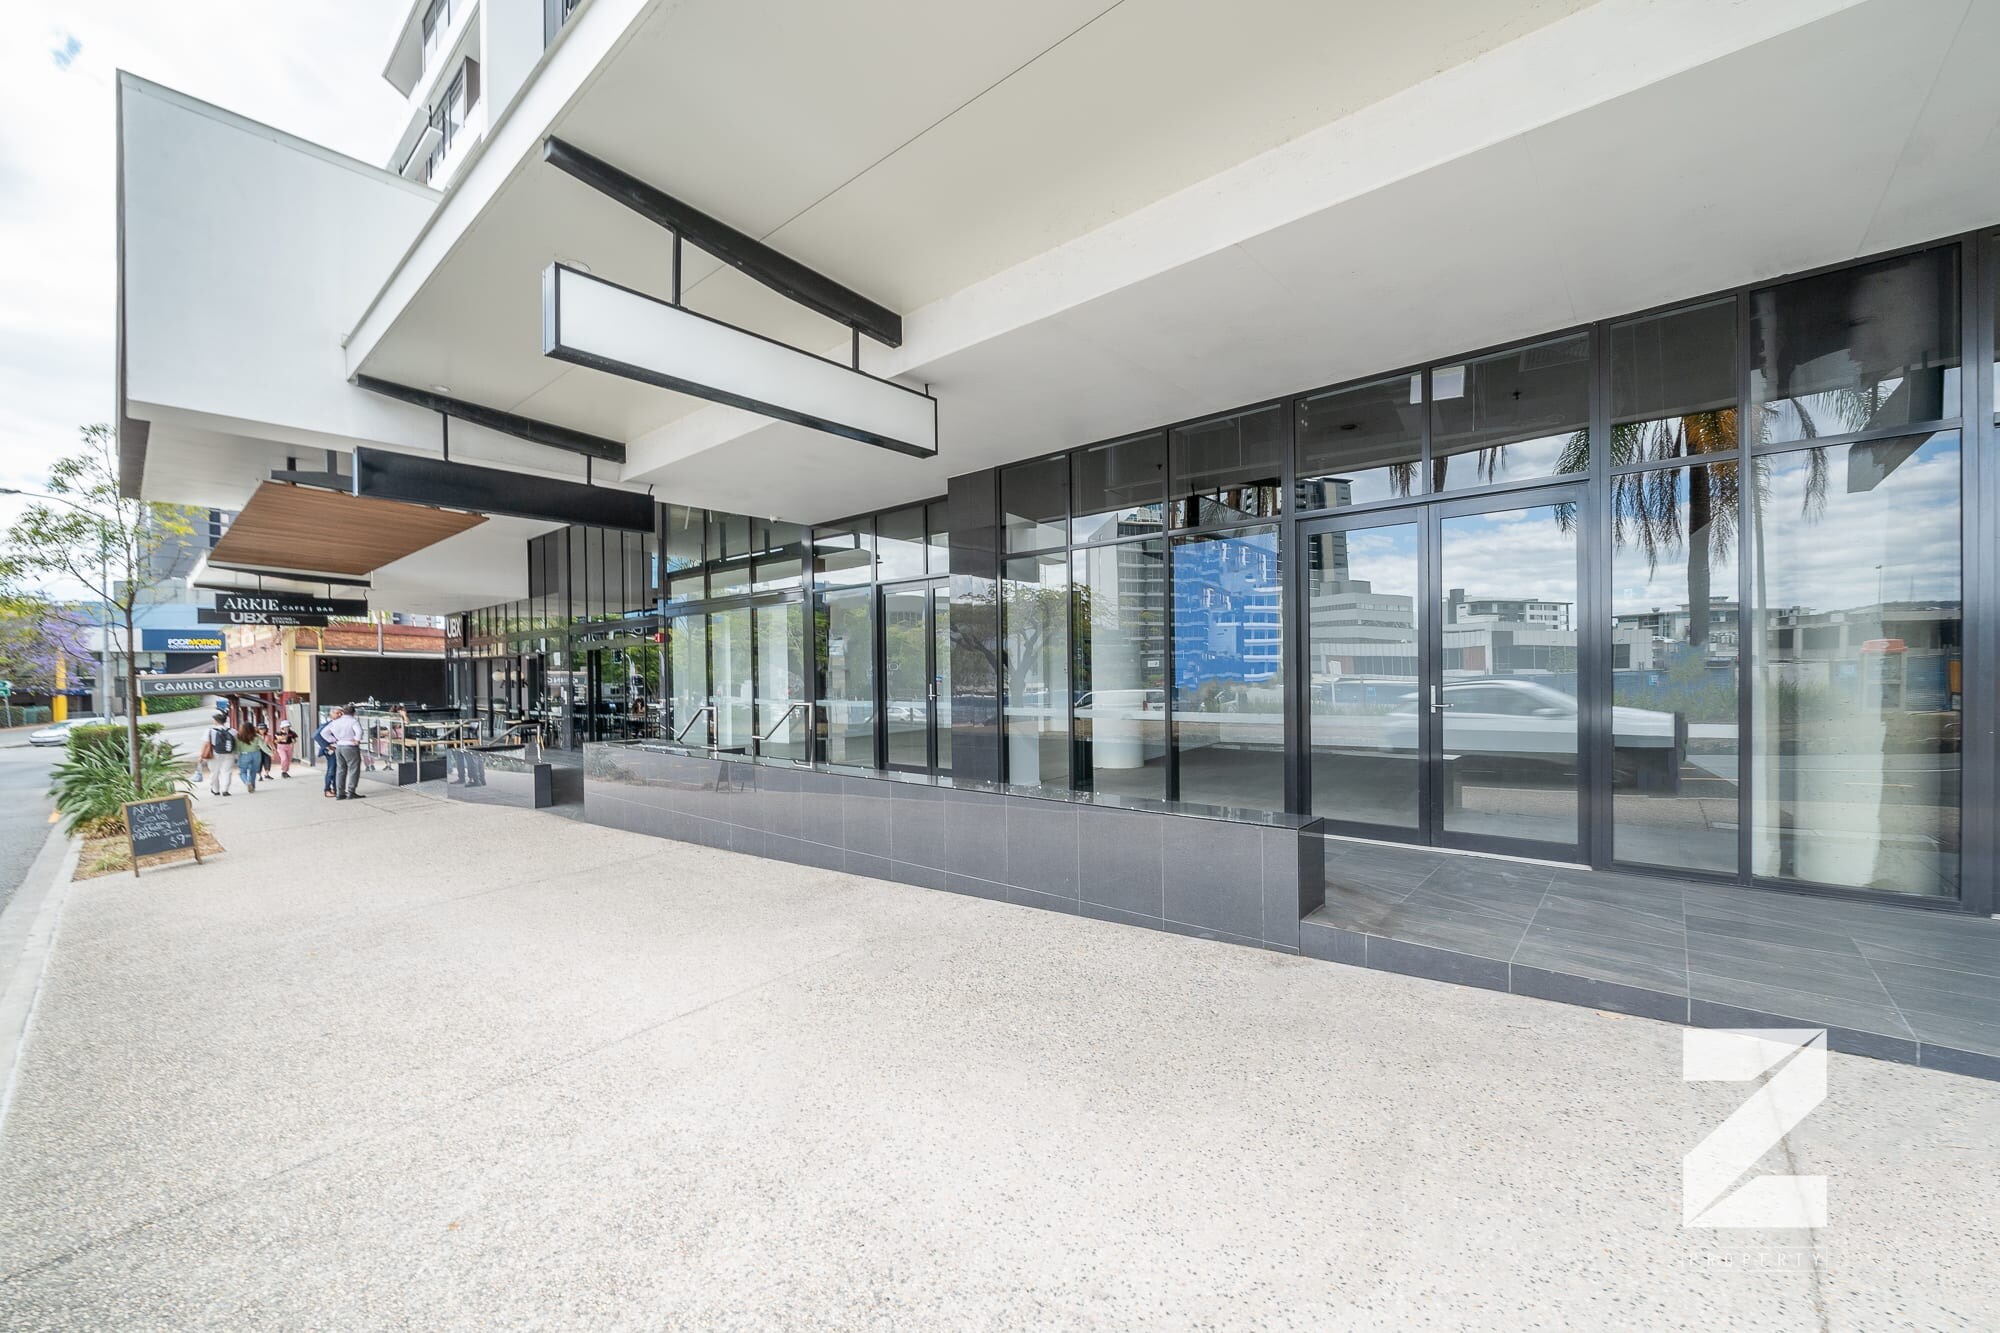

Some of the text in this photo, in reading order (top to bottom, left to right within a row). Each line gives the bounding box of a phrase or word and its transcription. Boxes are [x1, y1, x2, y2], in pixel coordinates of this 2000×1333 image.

[223, 597, 279, 611] ARKIE
[230, 612, 269, 624] UBX
[446, 617, 462, 638] UBX
[154, 679, 271, 692] GAMING LOUNGE
